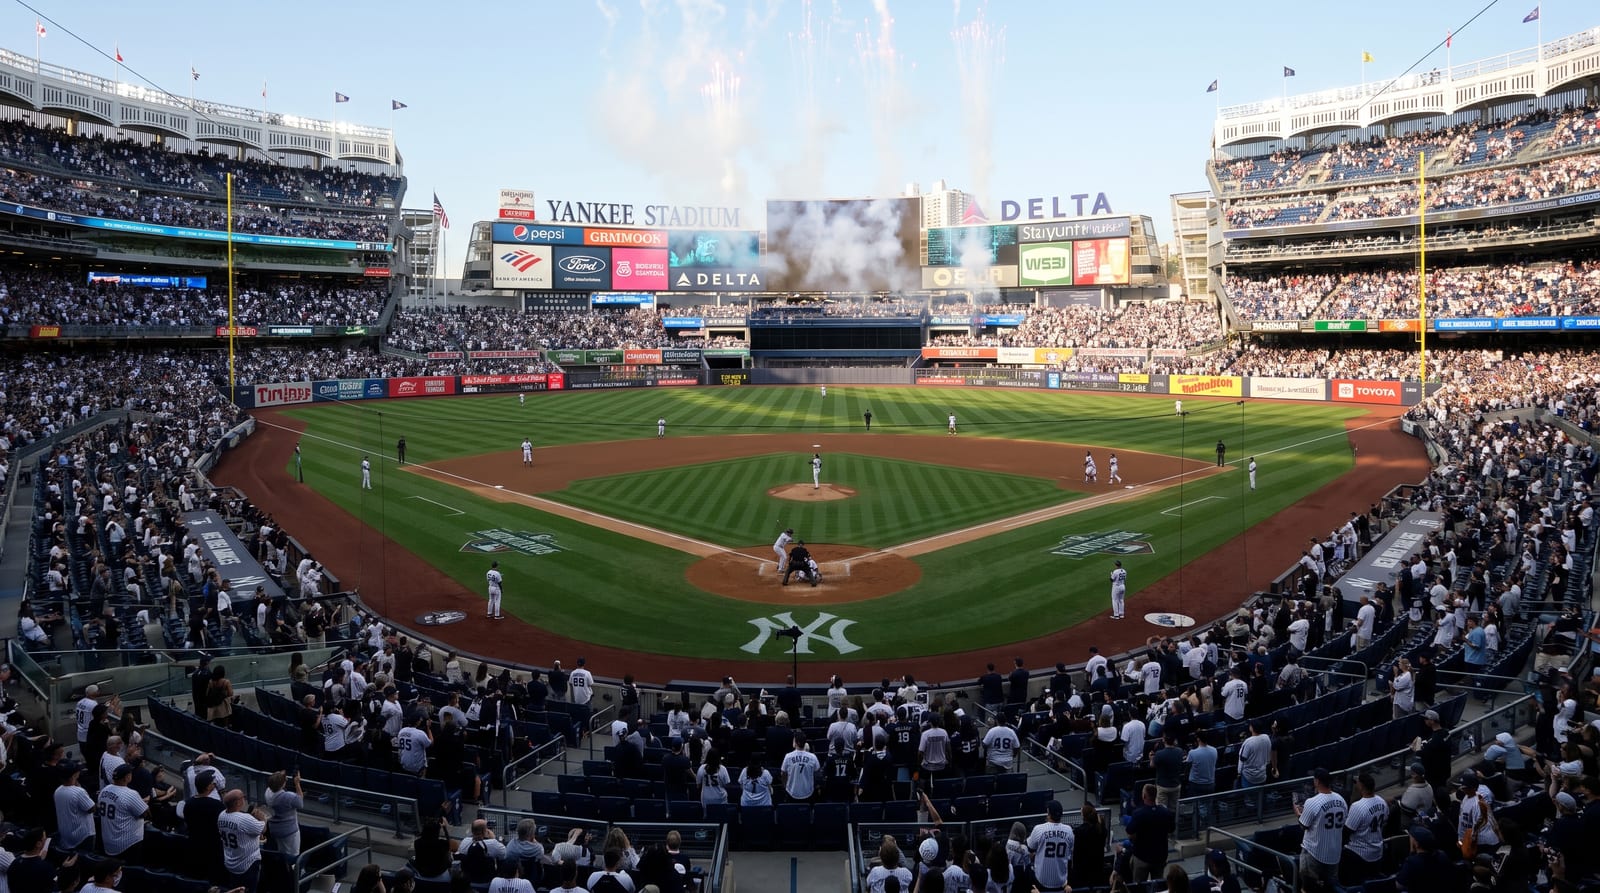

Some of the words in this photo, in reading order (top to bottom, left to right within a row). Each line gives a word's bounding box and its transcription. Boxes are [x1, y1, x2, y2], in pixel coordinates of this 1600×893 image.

[1001, 192, 1112, 221] DELTA
[547, 200, 635, 225] YANKEE
[645, 205, 741, 229] STADIUM
[531, 229, 565, 241] pepsi
[567, 257, 597, 272] Ford
[697, 273, 760, 286] DELTA
[1356, 387, 1395, 397] TOYOTA
[993, 738, 1011, 749] 48
[799, 763, 805, 773] 7
[835, 764, 847, 776] 17
[1325, 811, 1344, 829] 33
[1045, 842, 1067, 858] 20
